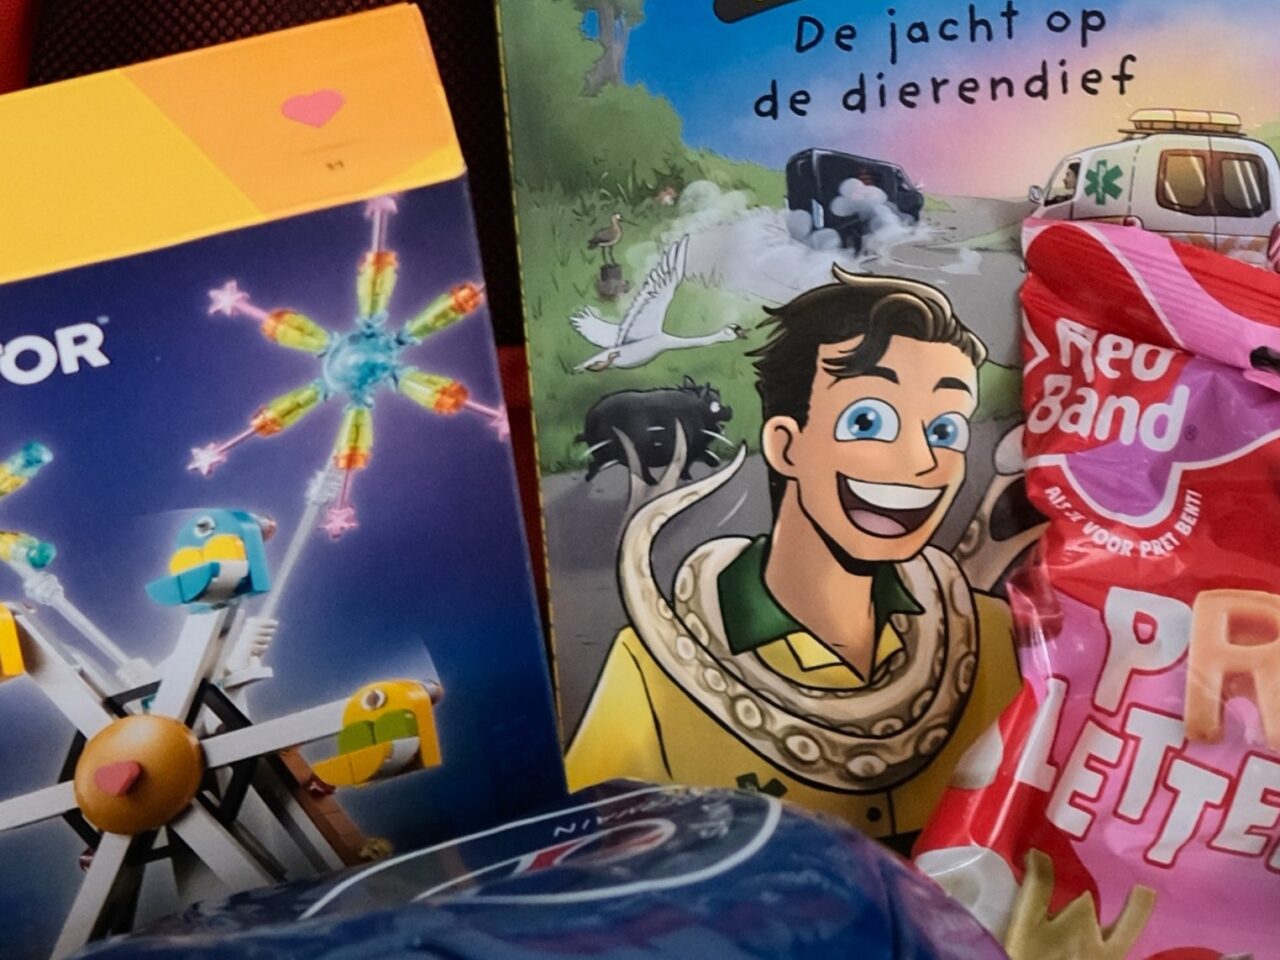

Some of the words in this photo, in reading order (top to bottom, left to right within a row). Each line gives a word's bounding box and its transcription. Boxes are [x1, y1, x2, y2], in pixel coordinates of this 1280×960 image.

[795, 16, 857, 53] De
[888, 0, 1019, 64] jacht
[1047, 9, 1106, 47] op
[754, 80, 812, 119] de
[842, 54, 1137, 113] dierendief
[0, 323, 111, 385] OR
[1027, 374, 1191, 452] Band
[1082, 521, 1134, 557] VOOR
[1138, 531, 1181, 558] PRET
[1174, 489, 1202, 537] BENT!
